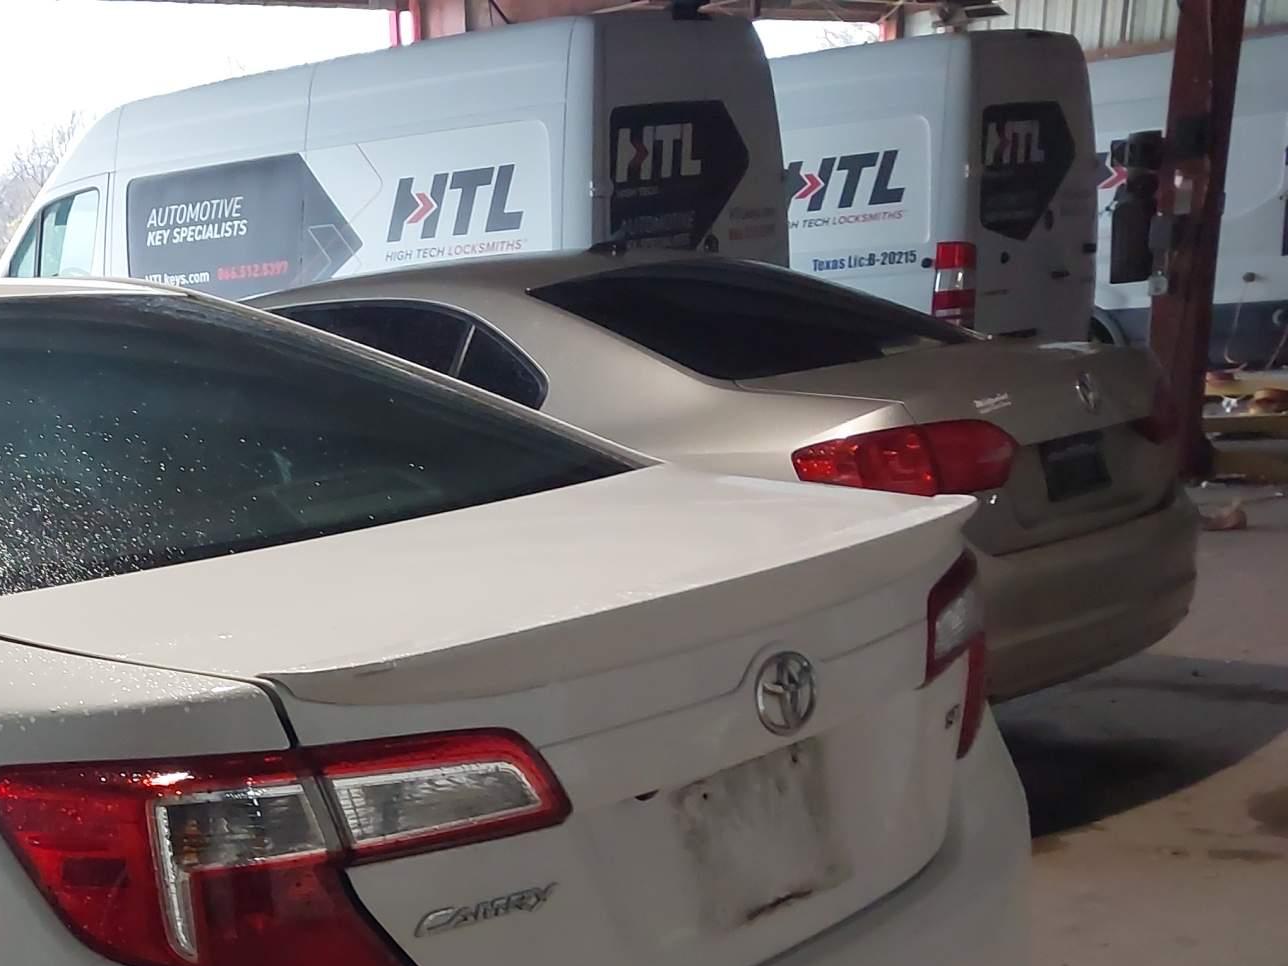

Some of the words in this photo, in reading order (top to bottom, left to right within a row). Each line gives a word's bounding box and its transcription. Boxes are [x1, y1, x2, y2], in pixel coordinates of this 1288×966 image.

[615, 122, 701, 183] HTL
[147, 196, 244, 228] AUTOMOTIVE
[386, 163, 524, 243] HTL
[147, 229, 170, 247] KEY
[172, 219, 248, 244] SPECIALISTS
[802, 217, 831, 229] TECH
[832, 209, 904, 226] LOCKSMITHS
[385, 250, 413, 262] HIGH
[416, 247, 445, 260] TECH
[448, 239, 523, 257] LOCKSMITHS
[813, 258, 846, 272] Texas
